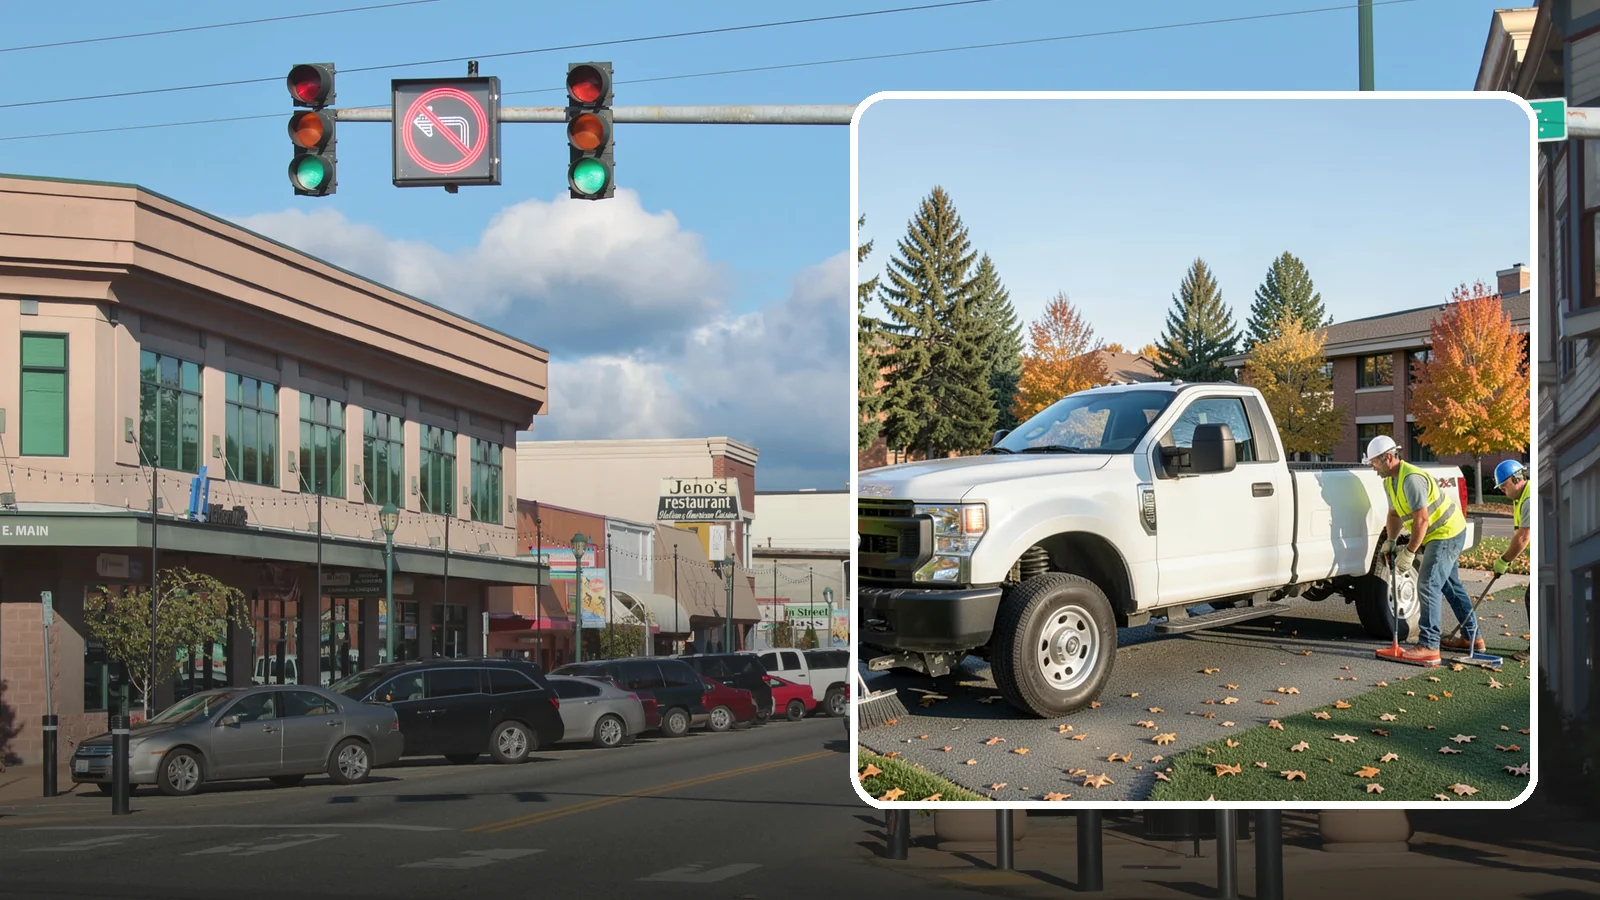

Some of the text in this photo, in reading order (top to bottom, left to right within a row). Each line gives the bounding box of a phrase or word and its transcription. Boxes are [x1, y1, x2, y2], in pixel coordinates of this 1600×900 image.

[670, 480, 727, 495] Jeno's
[665, 496, 731, 509] restaurant
[659, 510, 681, 519] Italian
[686, 510, 714, 519] American
[715, 510, 737, 519] Cuisine
[2, 525, 49, 536] E. MAIN
[797, 607, 829, 616] Street
